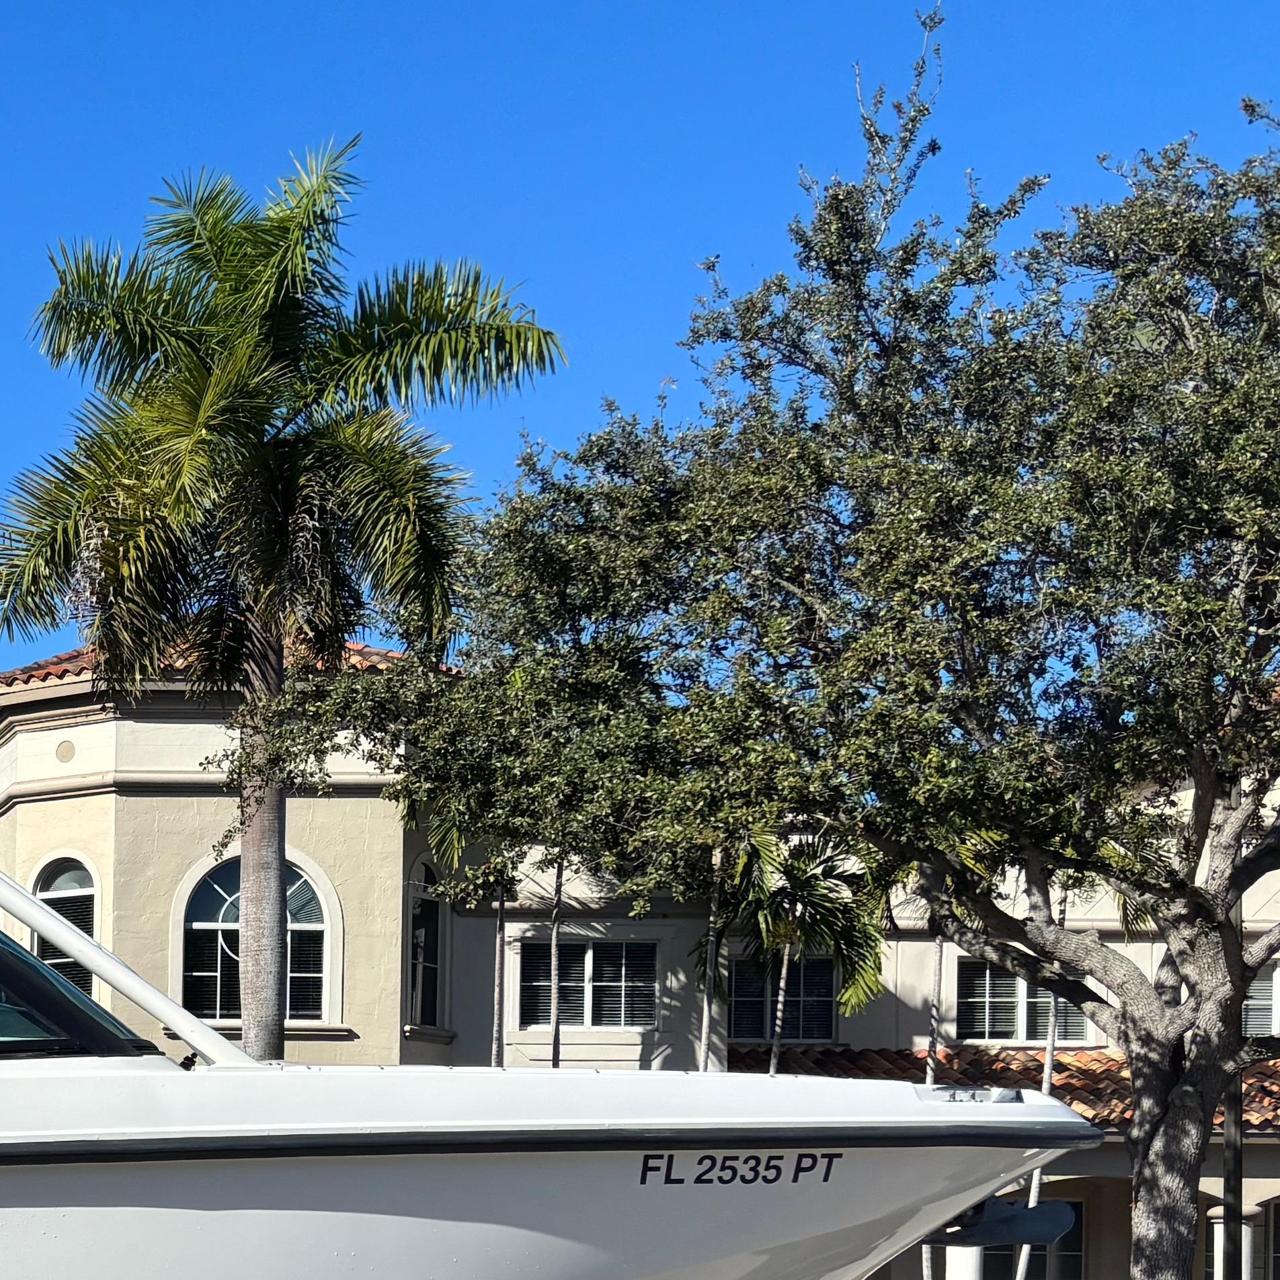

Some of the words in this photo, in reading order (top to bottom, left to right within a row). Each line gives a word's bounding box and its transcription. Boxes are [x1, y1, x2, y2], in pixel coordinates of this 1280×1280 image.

[639, 1154, 685, 1185] FL
[693, 1154, 784, 1185] 2535
[791, 1153, 843, 1183] PT
